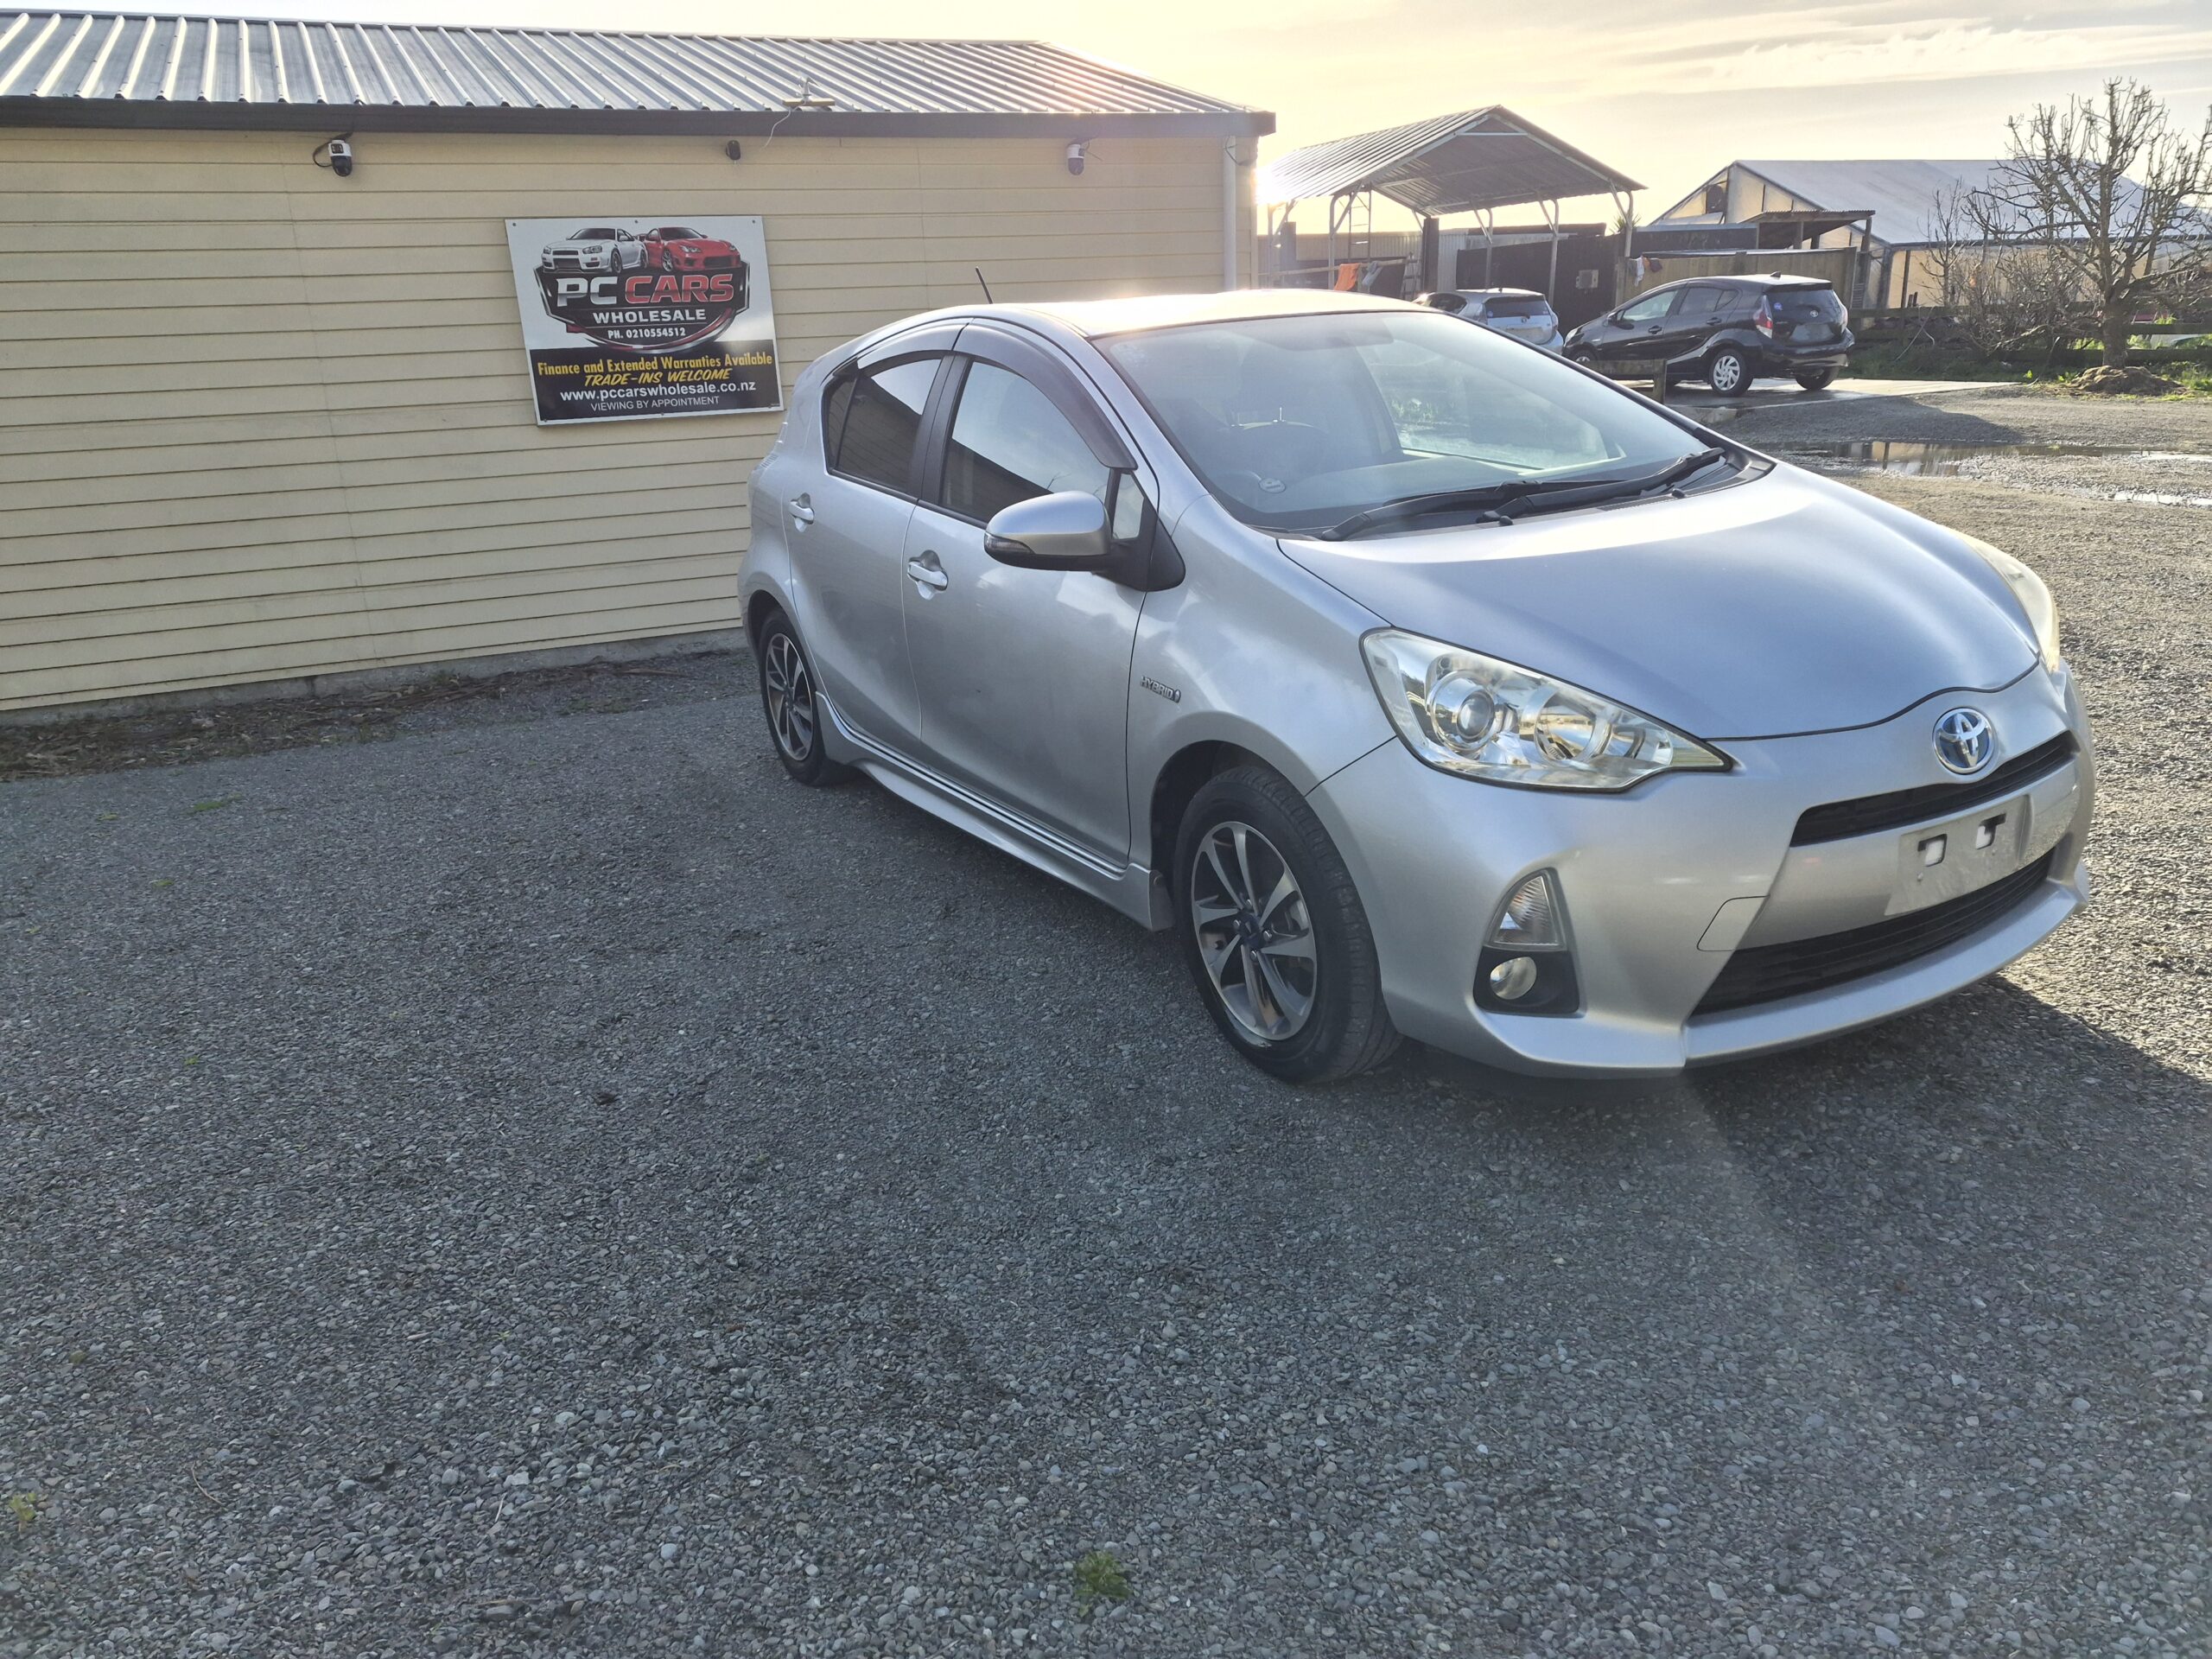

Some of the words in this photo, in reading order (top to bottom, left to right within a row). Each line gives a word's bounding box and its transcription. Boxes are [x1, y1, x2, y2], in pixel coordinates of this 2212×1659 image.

[556, 276, 618, 307] PC
[625, 274, 734, 303] CARS
[593, 308, 707, 324] WHOLESALE
[607, 329, 624, 340] PH.
[626, 327, 686, 339] 0210554512
[537, 362, 581, 376] Finance
[583, 359, 604, 373] and
[607, 356, 658, 372] Extended
[660, 355, 721, 370] Warranties
[724, 352, 772, 366] Available
[584, 372, 663, 387] TRADE-INS
[667, 368, 733, 383] WELCOME
[560, 381, 756, 401] www.pccarswholesale.co.nz
[591, 401, 634, 411] VIEWING
[636, 400, 649, 409] BY
[652, 396, 720, 408] APPOINTMENT
[1141, 675, 1174, 700] HYBRID
